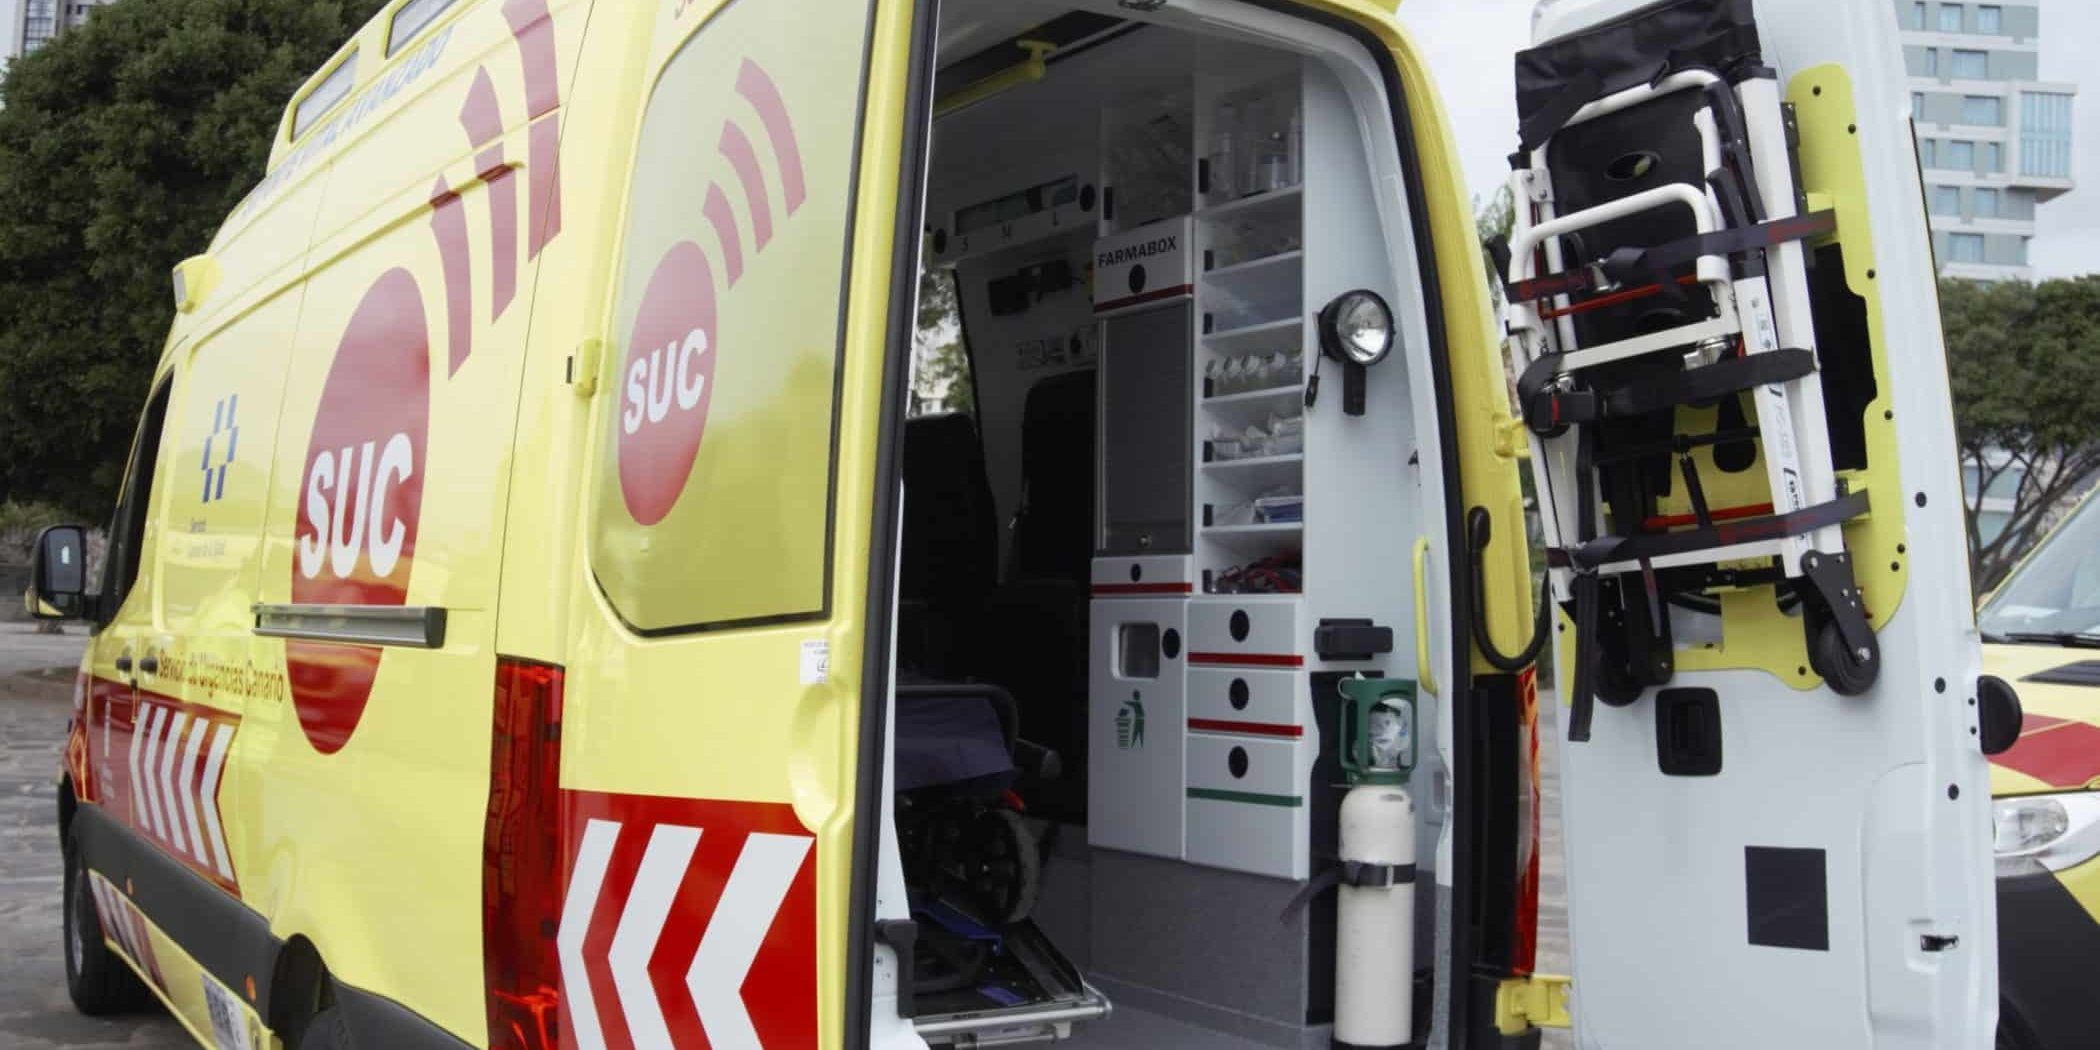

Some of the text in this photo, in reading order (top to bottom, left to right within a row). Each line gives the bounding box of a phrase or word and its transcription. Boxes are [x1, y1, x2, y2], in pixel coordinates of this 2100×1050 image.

[1097, 235, 1177, 268] FARMABOX
[623, 326, 708, 435] SUC
[300, 431, 414, 580] SUC
[245, 658, 284, 702] Canario
